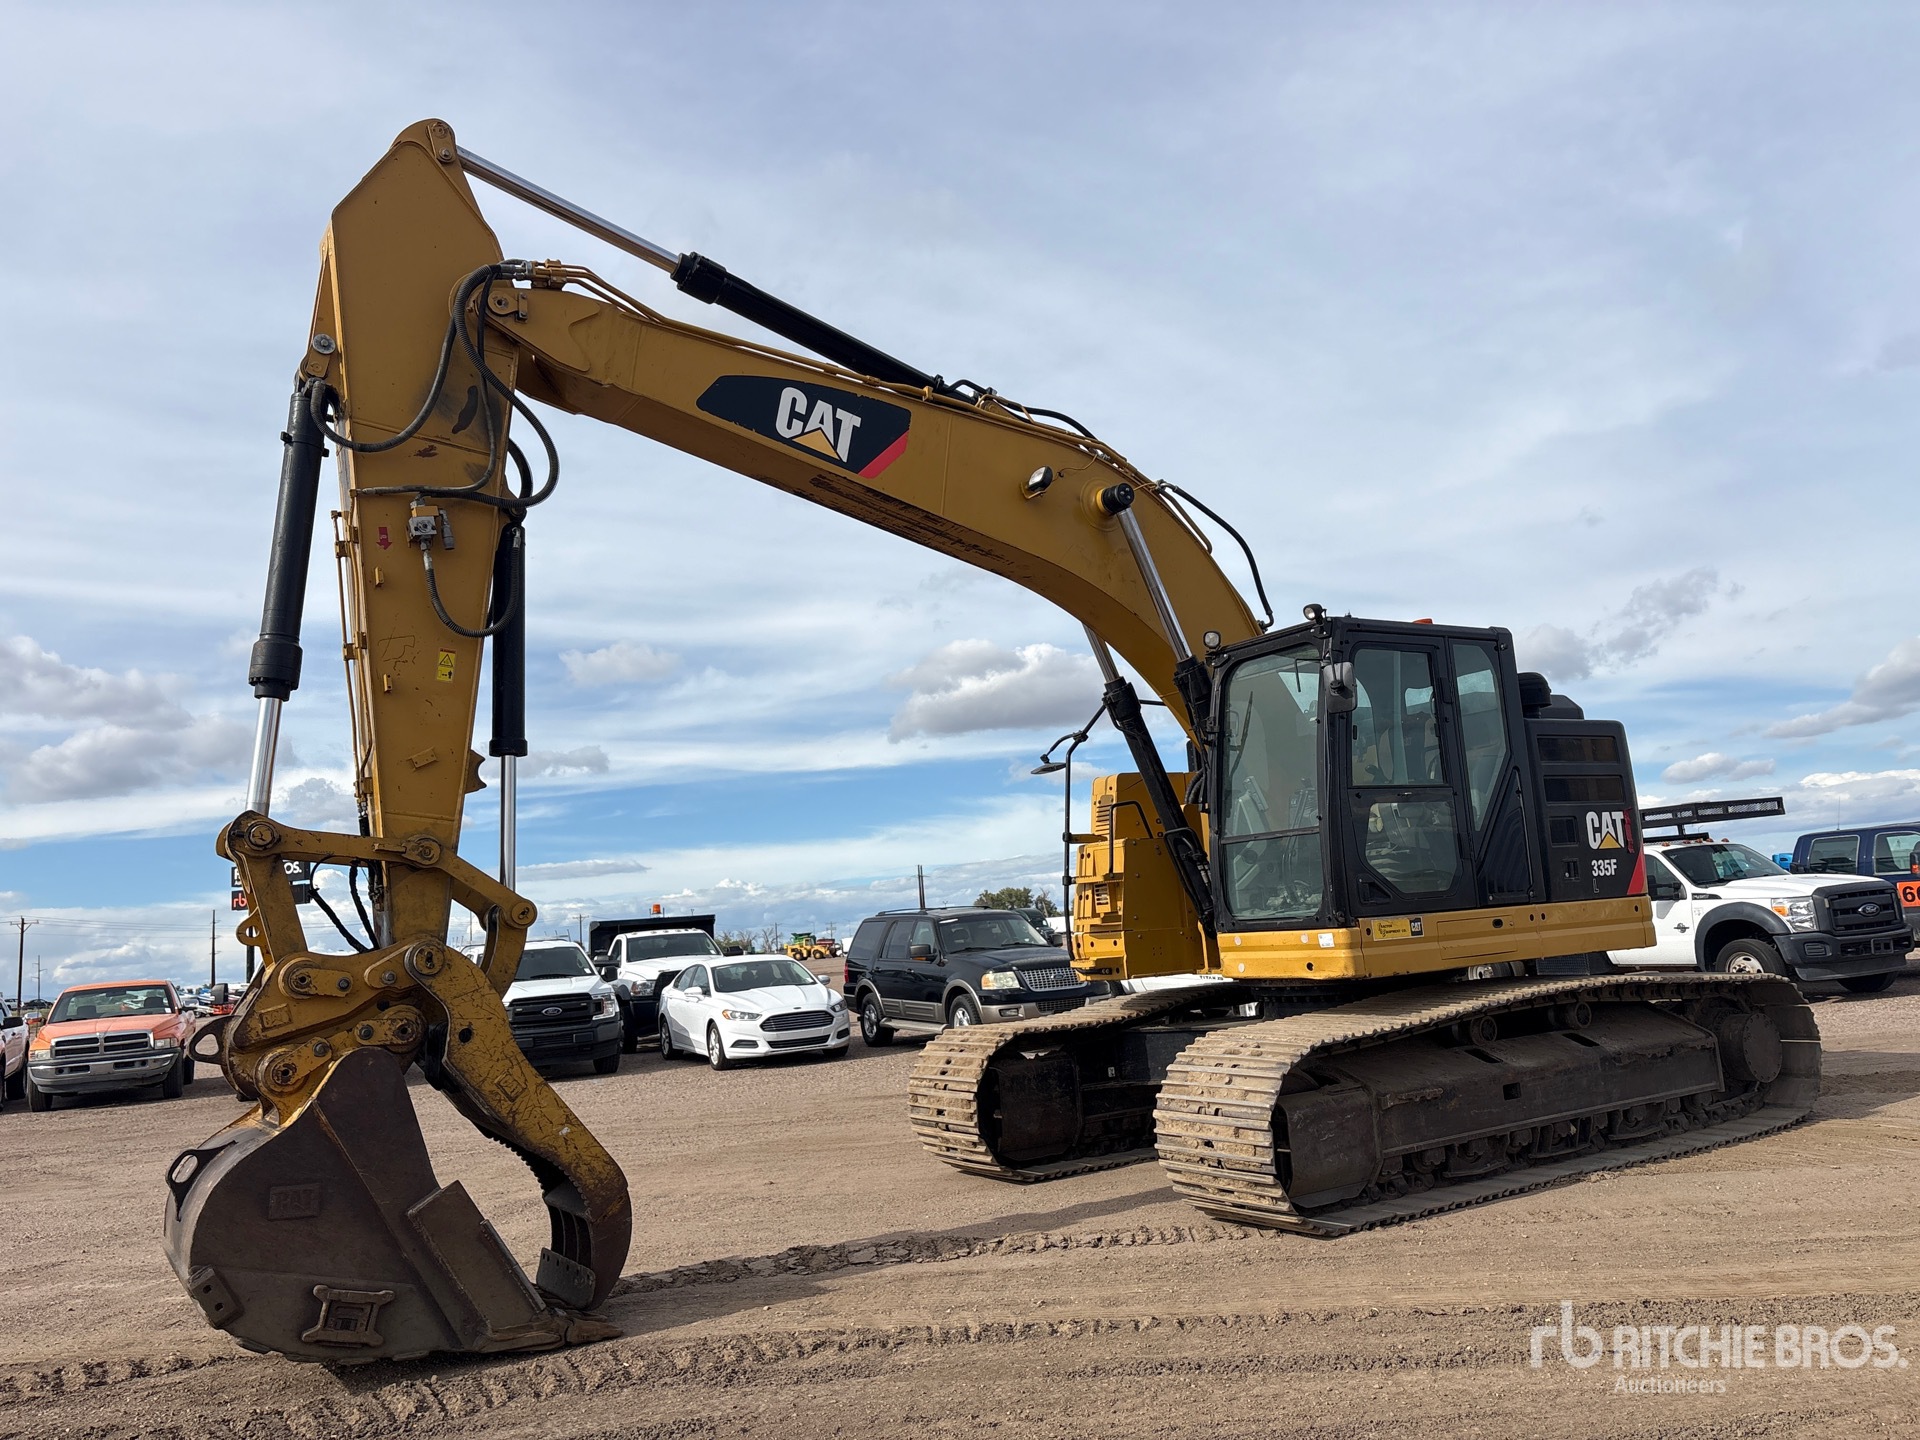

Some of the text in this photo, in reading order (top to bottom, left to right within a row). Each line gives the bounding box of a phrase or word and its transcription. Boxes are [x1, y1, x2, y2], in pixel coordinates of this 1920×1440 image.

[775, 386, 862, 463] CAT
[1586, 811, 1625, 850] CAT
[283, 861, 302, 875] OS.
[1591, 859, 1618, 877] 335F
[233, 893, 247, 908] rb
[1410, 922, 1421, 932] CAT
